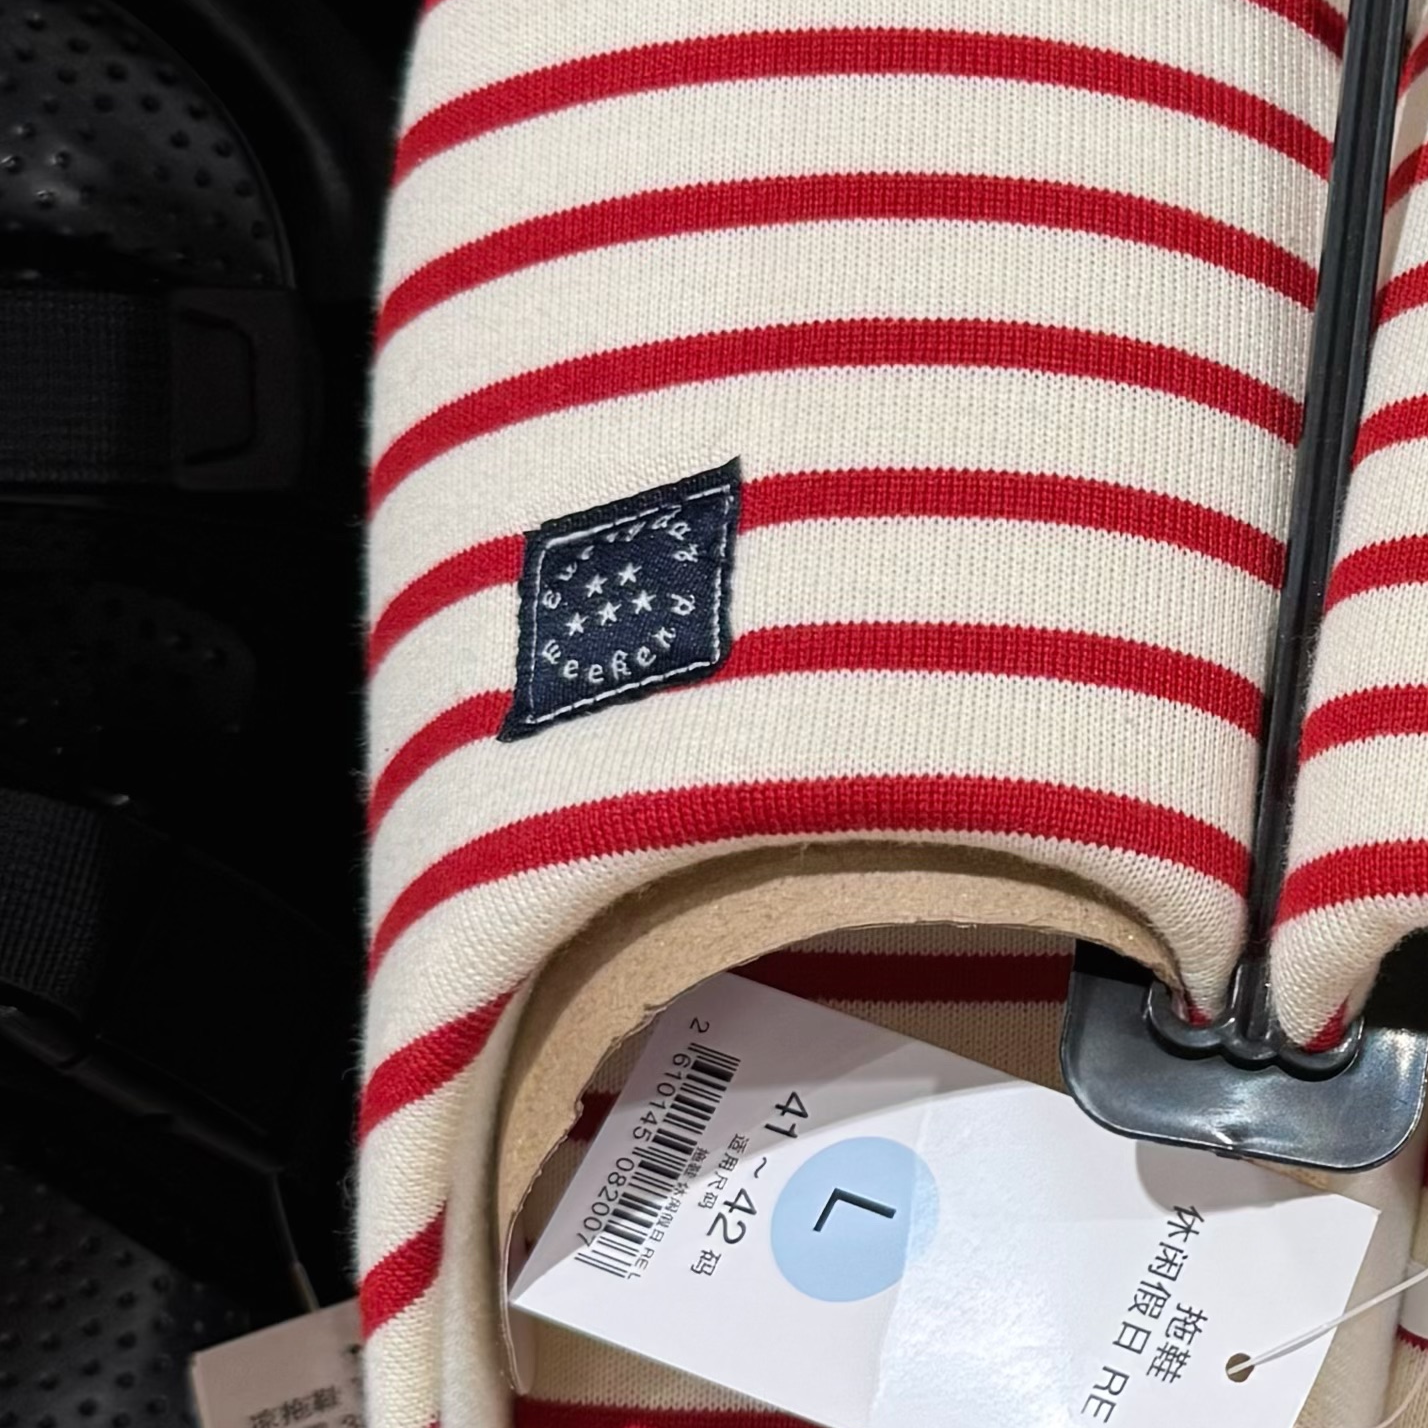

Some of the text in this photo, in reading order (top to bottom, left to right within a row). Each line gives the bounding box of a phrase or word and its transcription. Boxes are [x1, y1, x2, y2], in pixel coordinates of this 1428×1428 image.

[543, 594, 696, 684] Weekend
[576, 1017, 710, 1248] 2 610145 082007
[698, 1132, 750, 1209] 适用尺码
[812, 1187, 896, 1232] L
[1112, 1205, 1205, 1355] 休闲假日
[1146, 1302, 1209, 1384] 拖鞋
[1080, 1365, 1130, 1423] RE
